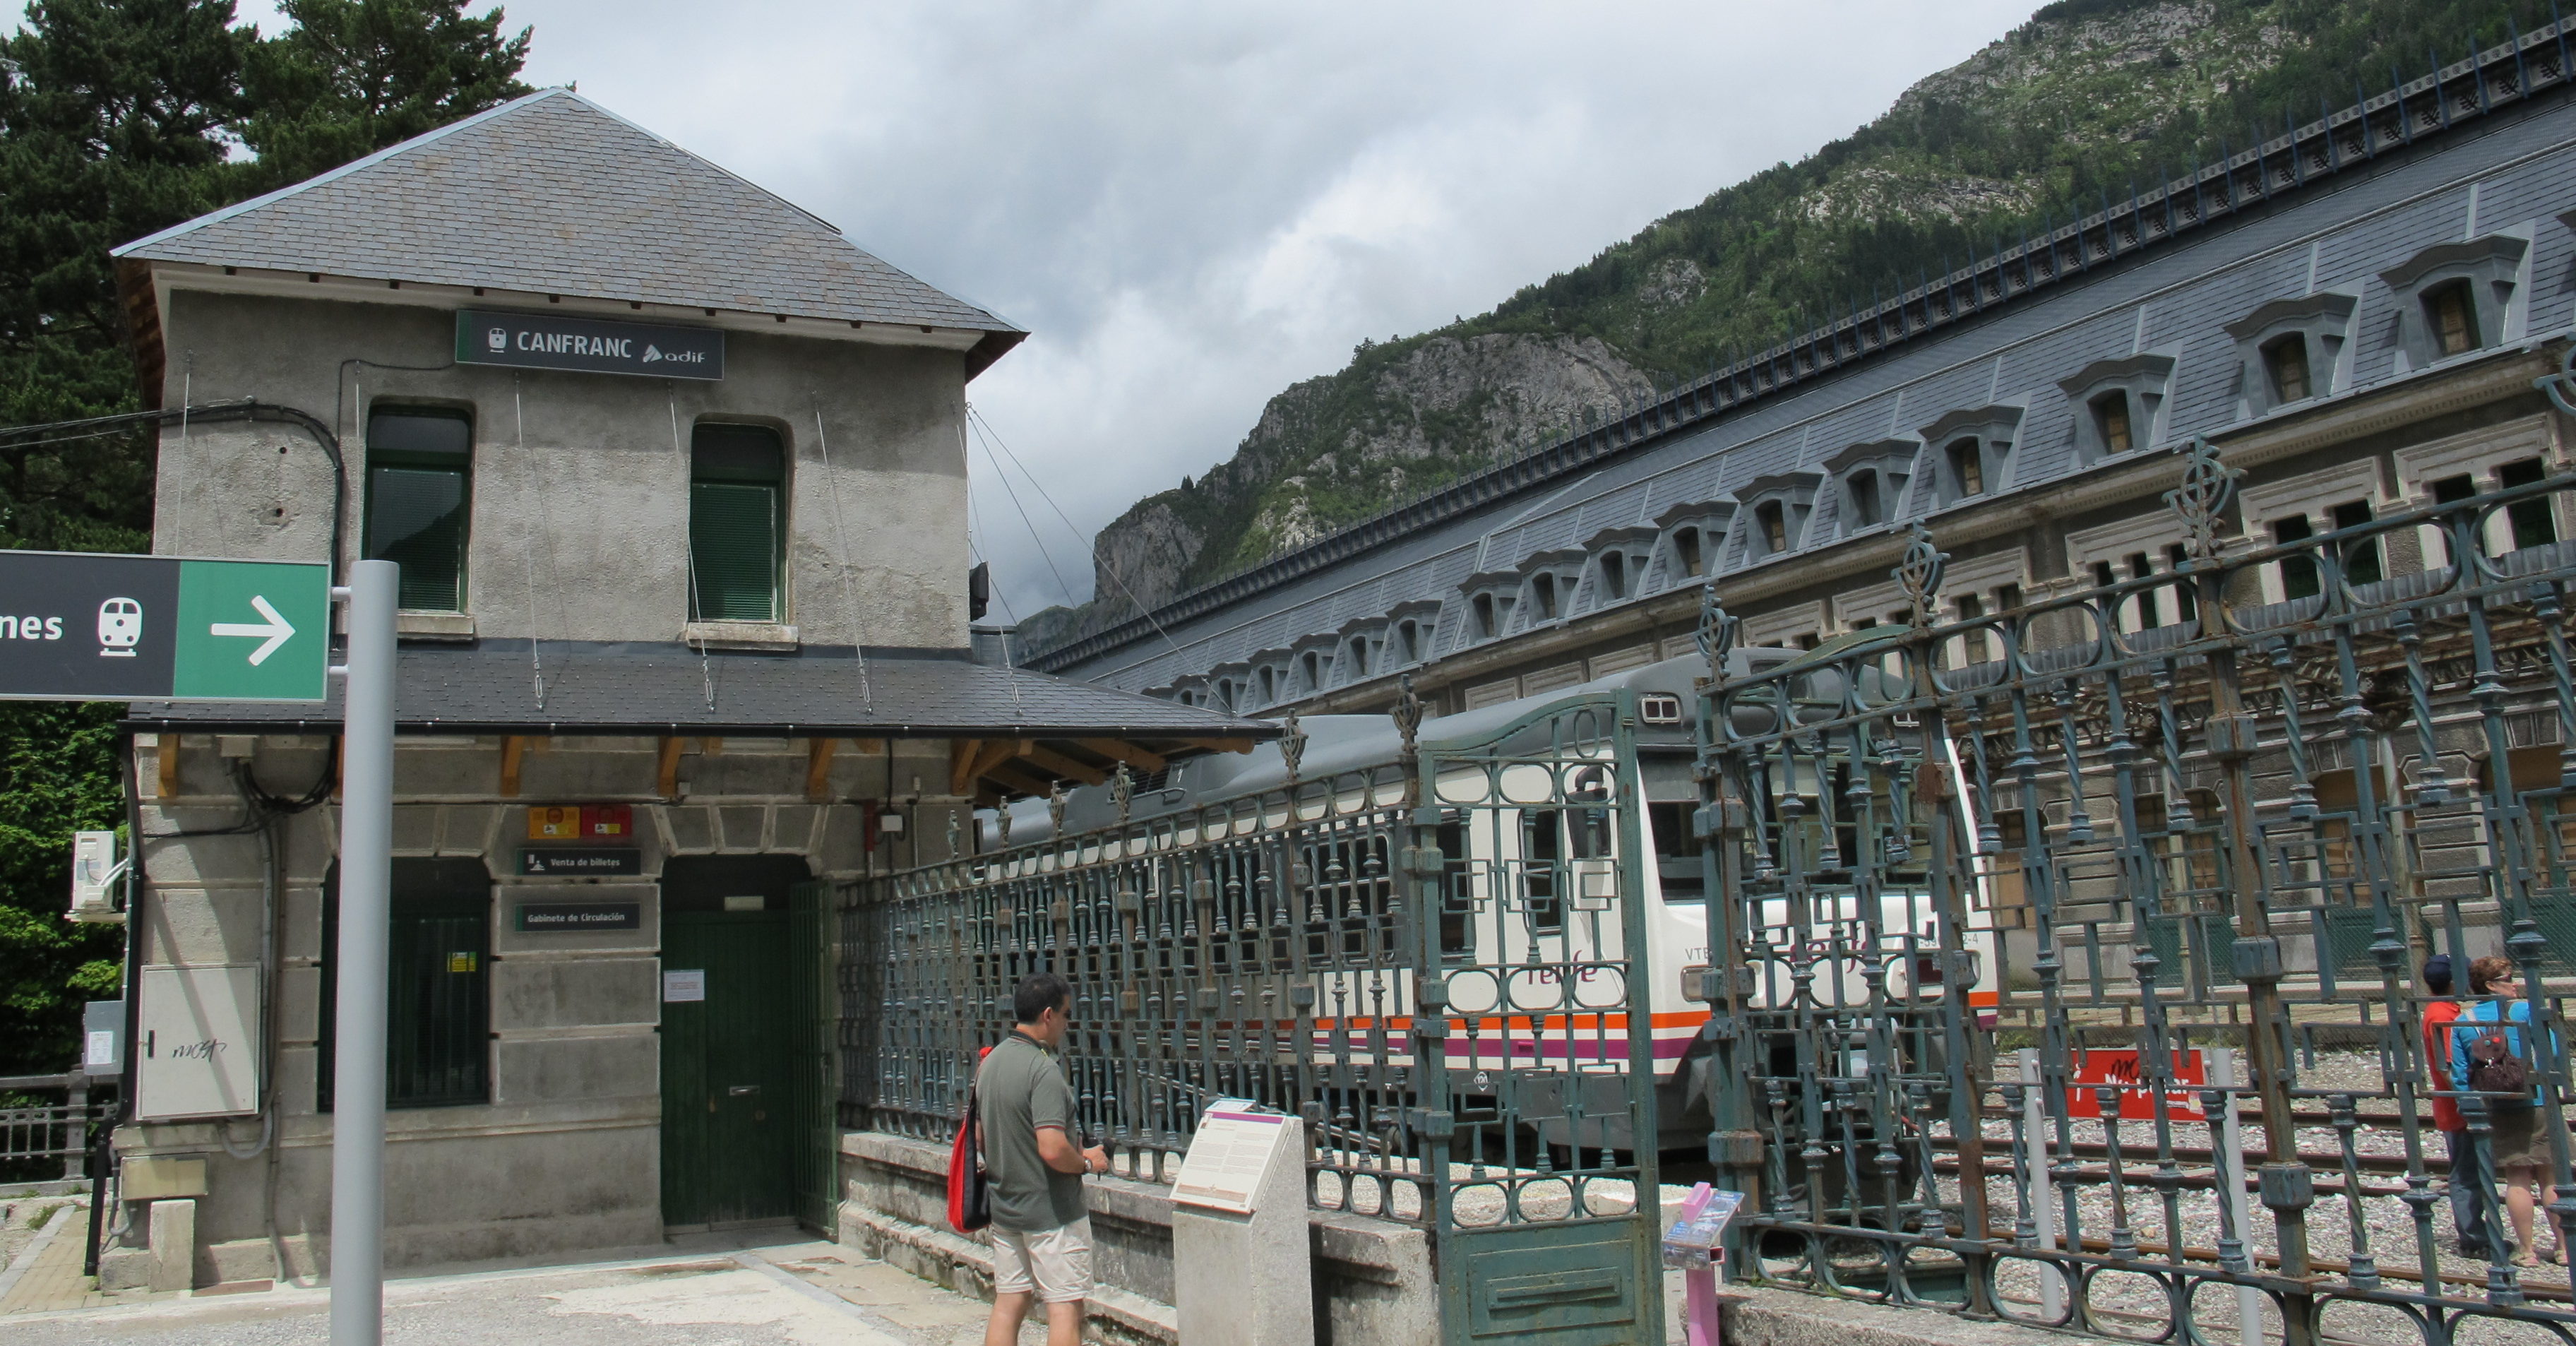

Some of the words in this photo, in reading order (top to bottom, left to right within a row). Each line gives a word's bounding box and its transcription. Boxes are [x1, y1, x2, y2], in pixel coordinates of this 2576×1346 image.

[517, 331, 632, 359] CANFRANC
[664, 350, 706, 364] adif
[0, 615, 64, 641] nes
[550, 858, 576, 866] Venta
[577, 858, 588, 866] de
[590, 857, 621, 867] billetes
[527, 915, 566, 923] Gabinete
[567, 913, 579, 922] de
[580, 912, 626, 922] Circulación
[2136, 1077, 2190, 1099] par
